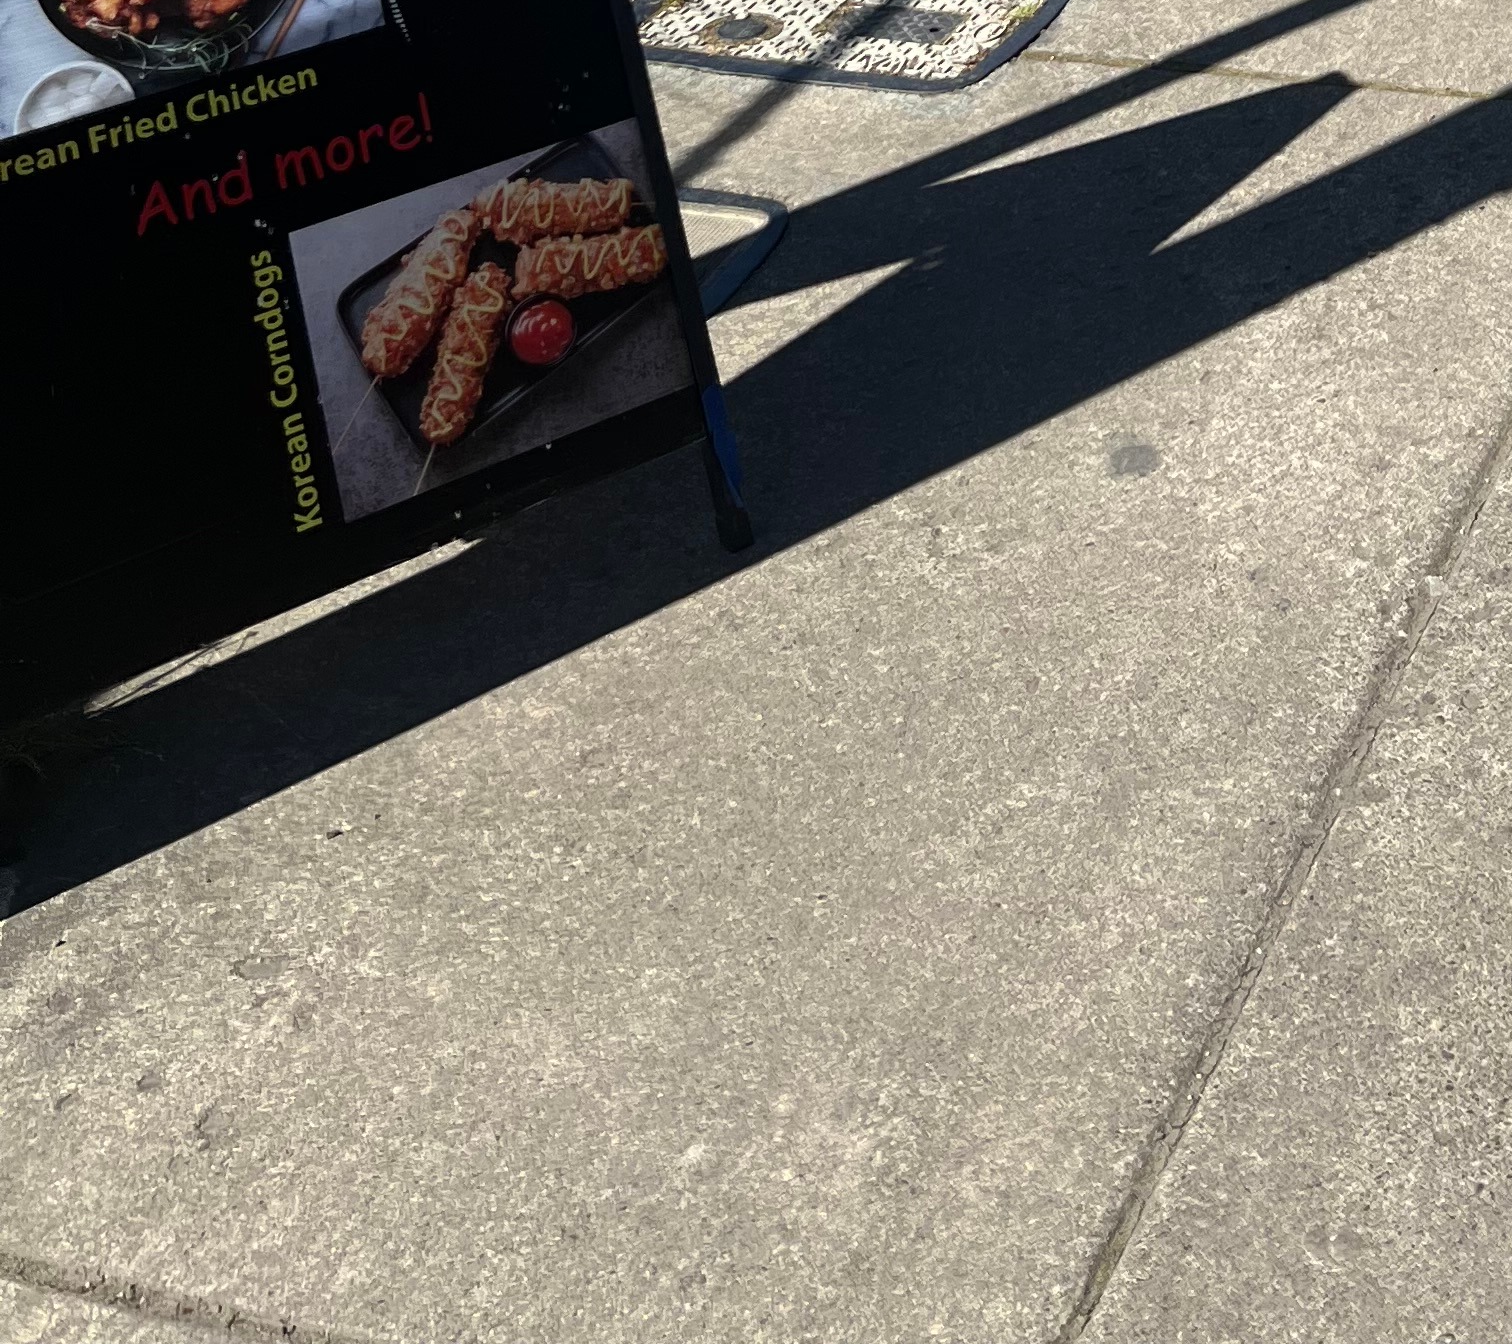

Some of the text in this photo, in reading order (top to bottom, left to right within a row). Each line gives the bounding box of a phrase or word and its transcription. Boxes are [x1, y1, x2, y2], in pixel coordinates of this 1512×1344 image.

[88, 102, 179, 155] Fried
[185, 66, 319, 124] Chicken
[137, 92, 433, 236] And more!
[250, 248, 323, 534] Korean Corndogs
